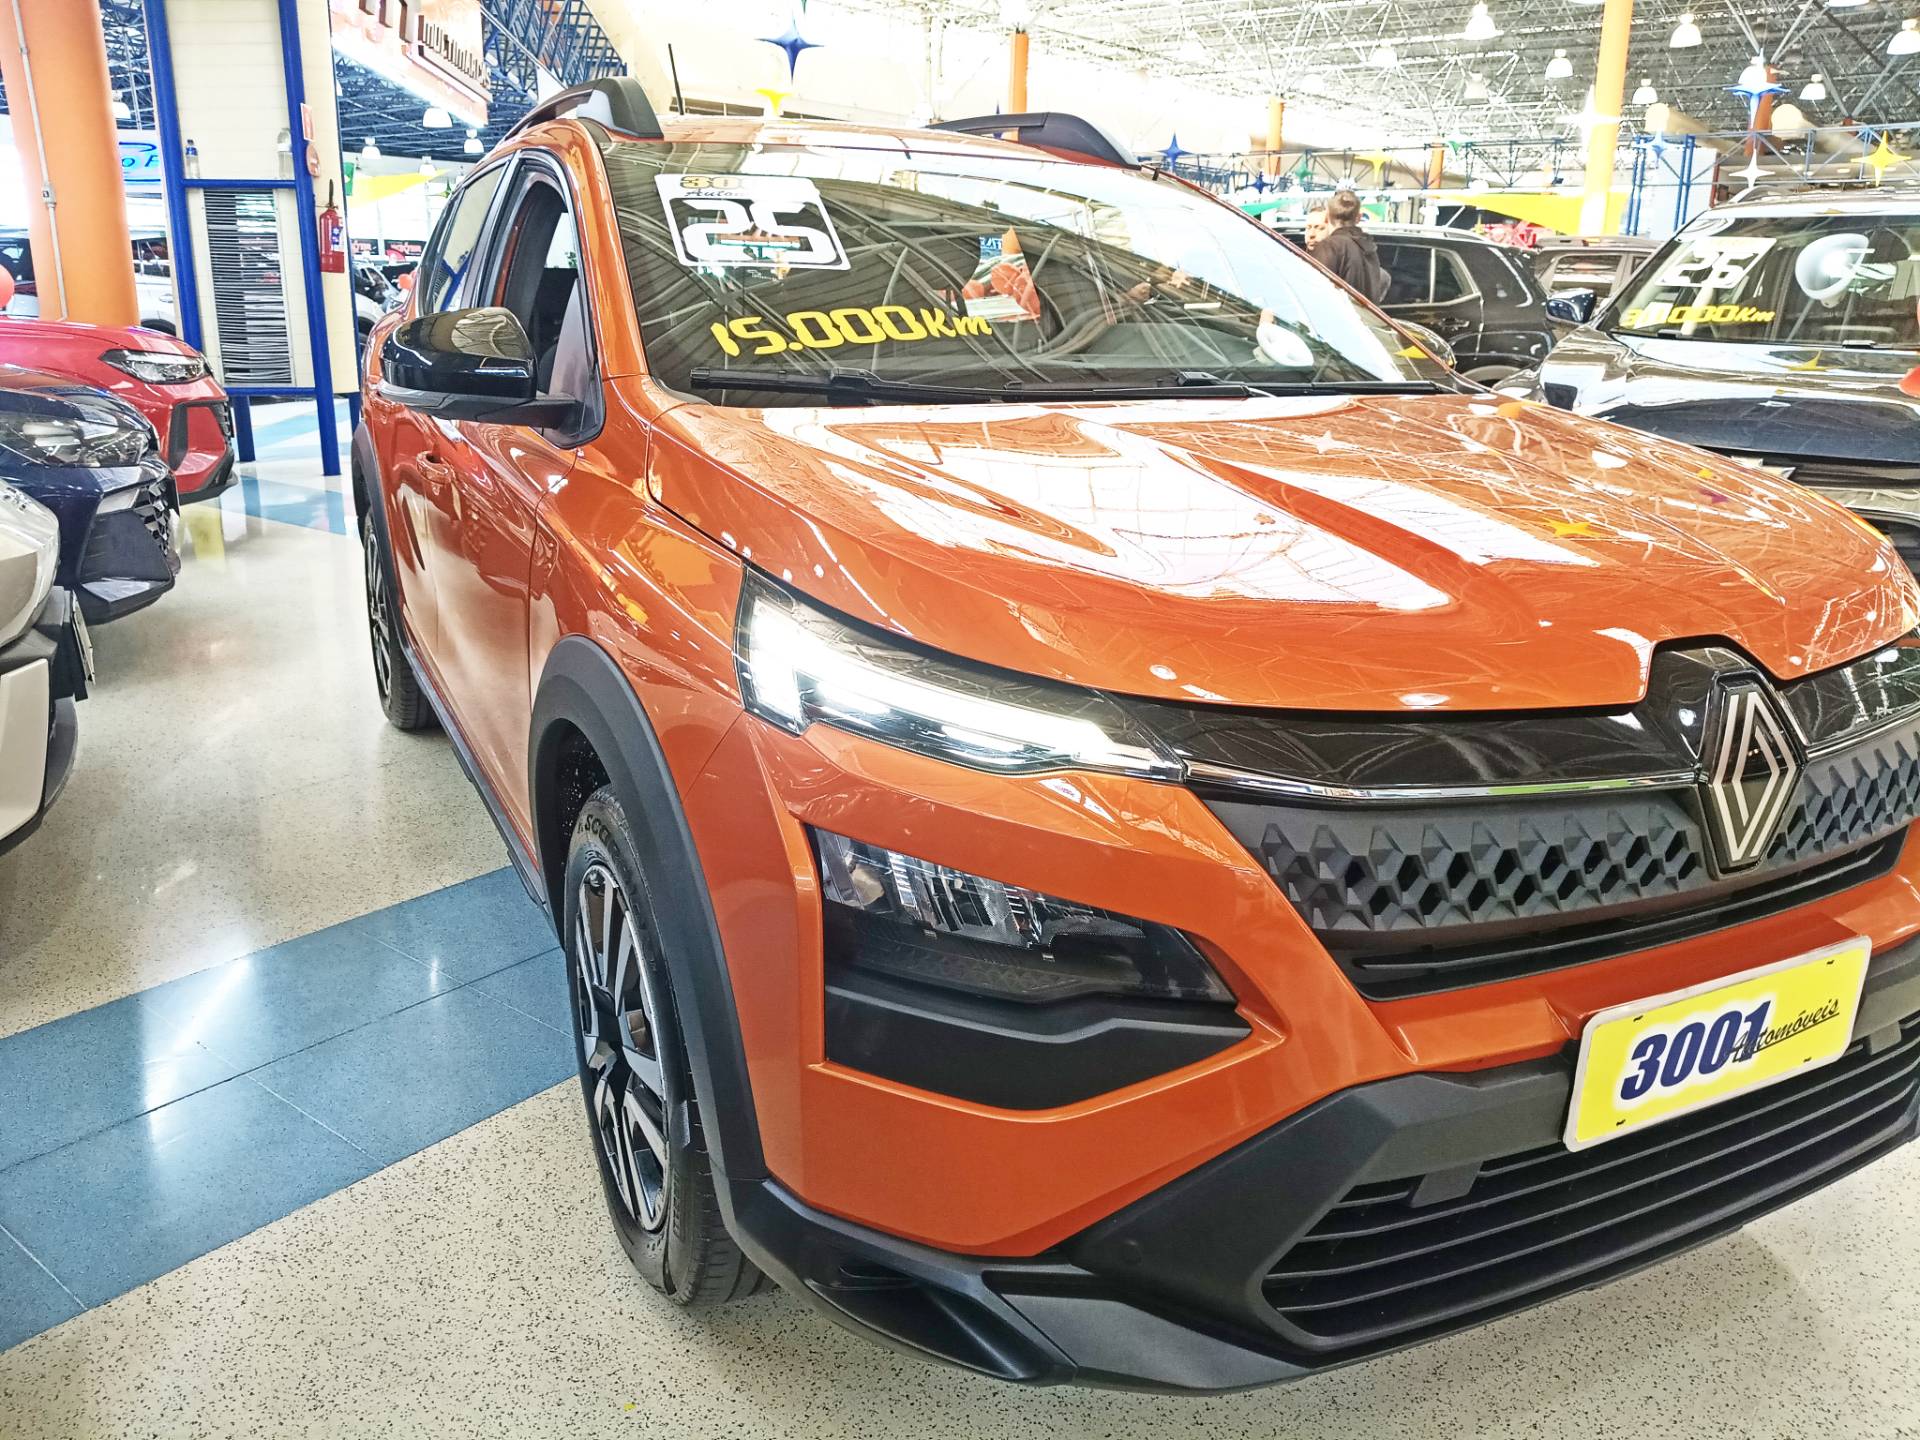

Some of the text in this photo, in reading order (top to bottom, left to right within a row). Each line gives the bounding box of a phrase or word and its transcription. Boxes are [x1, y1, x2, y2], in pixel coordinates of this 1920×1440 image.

[681, 199, 838, 264] 25
[1660, 249, 1758, 287] 26
[1619, 999, 1772, 1102] 3001
